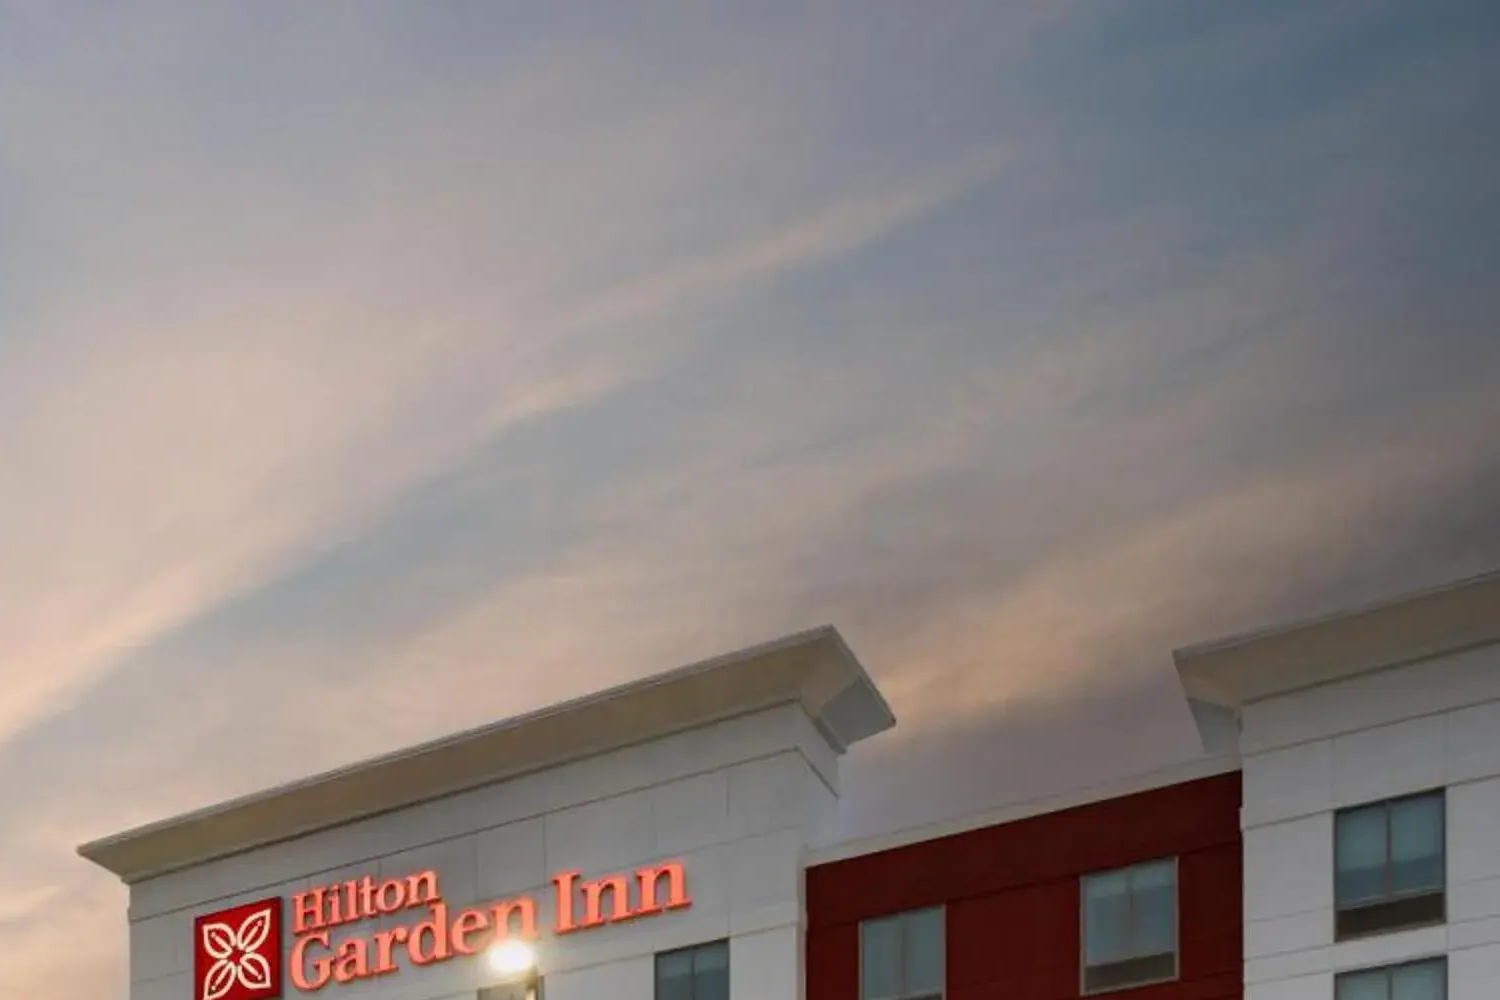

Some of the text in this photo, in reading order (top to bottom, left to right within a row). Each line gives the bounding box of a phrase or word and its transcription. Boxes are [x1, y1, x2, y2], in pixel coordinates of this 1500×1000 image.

[290, 860, 692, 991] Garden Inn
[292, 870, 441, 934] Hilton
